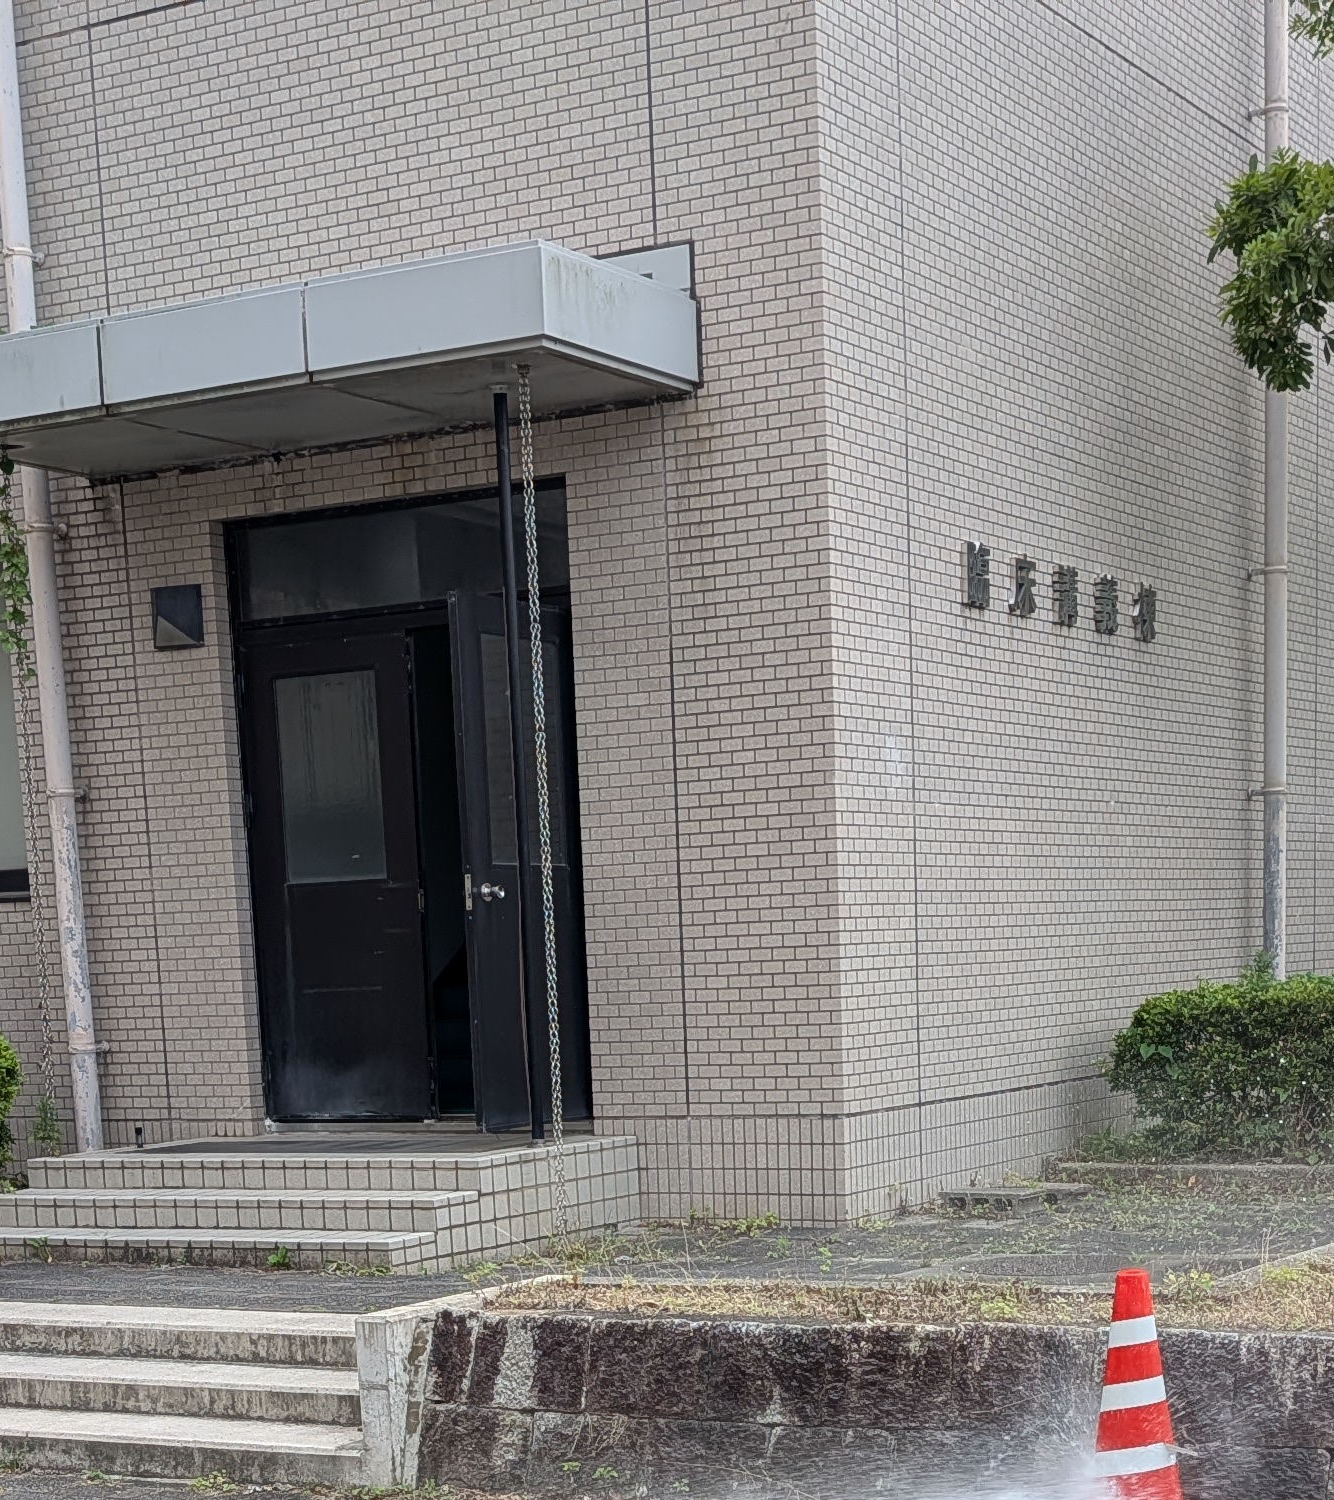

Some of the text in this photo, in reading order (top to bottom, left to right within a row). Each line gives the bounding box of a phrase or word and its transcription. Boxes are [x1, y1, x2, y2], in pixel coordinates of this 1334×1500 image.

[961, 541, 1156, 642] 臨床講義棟
